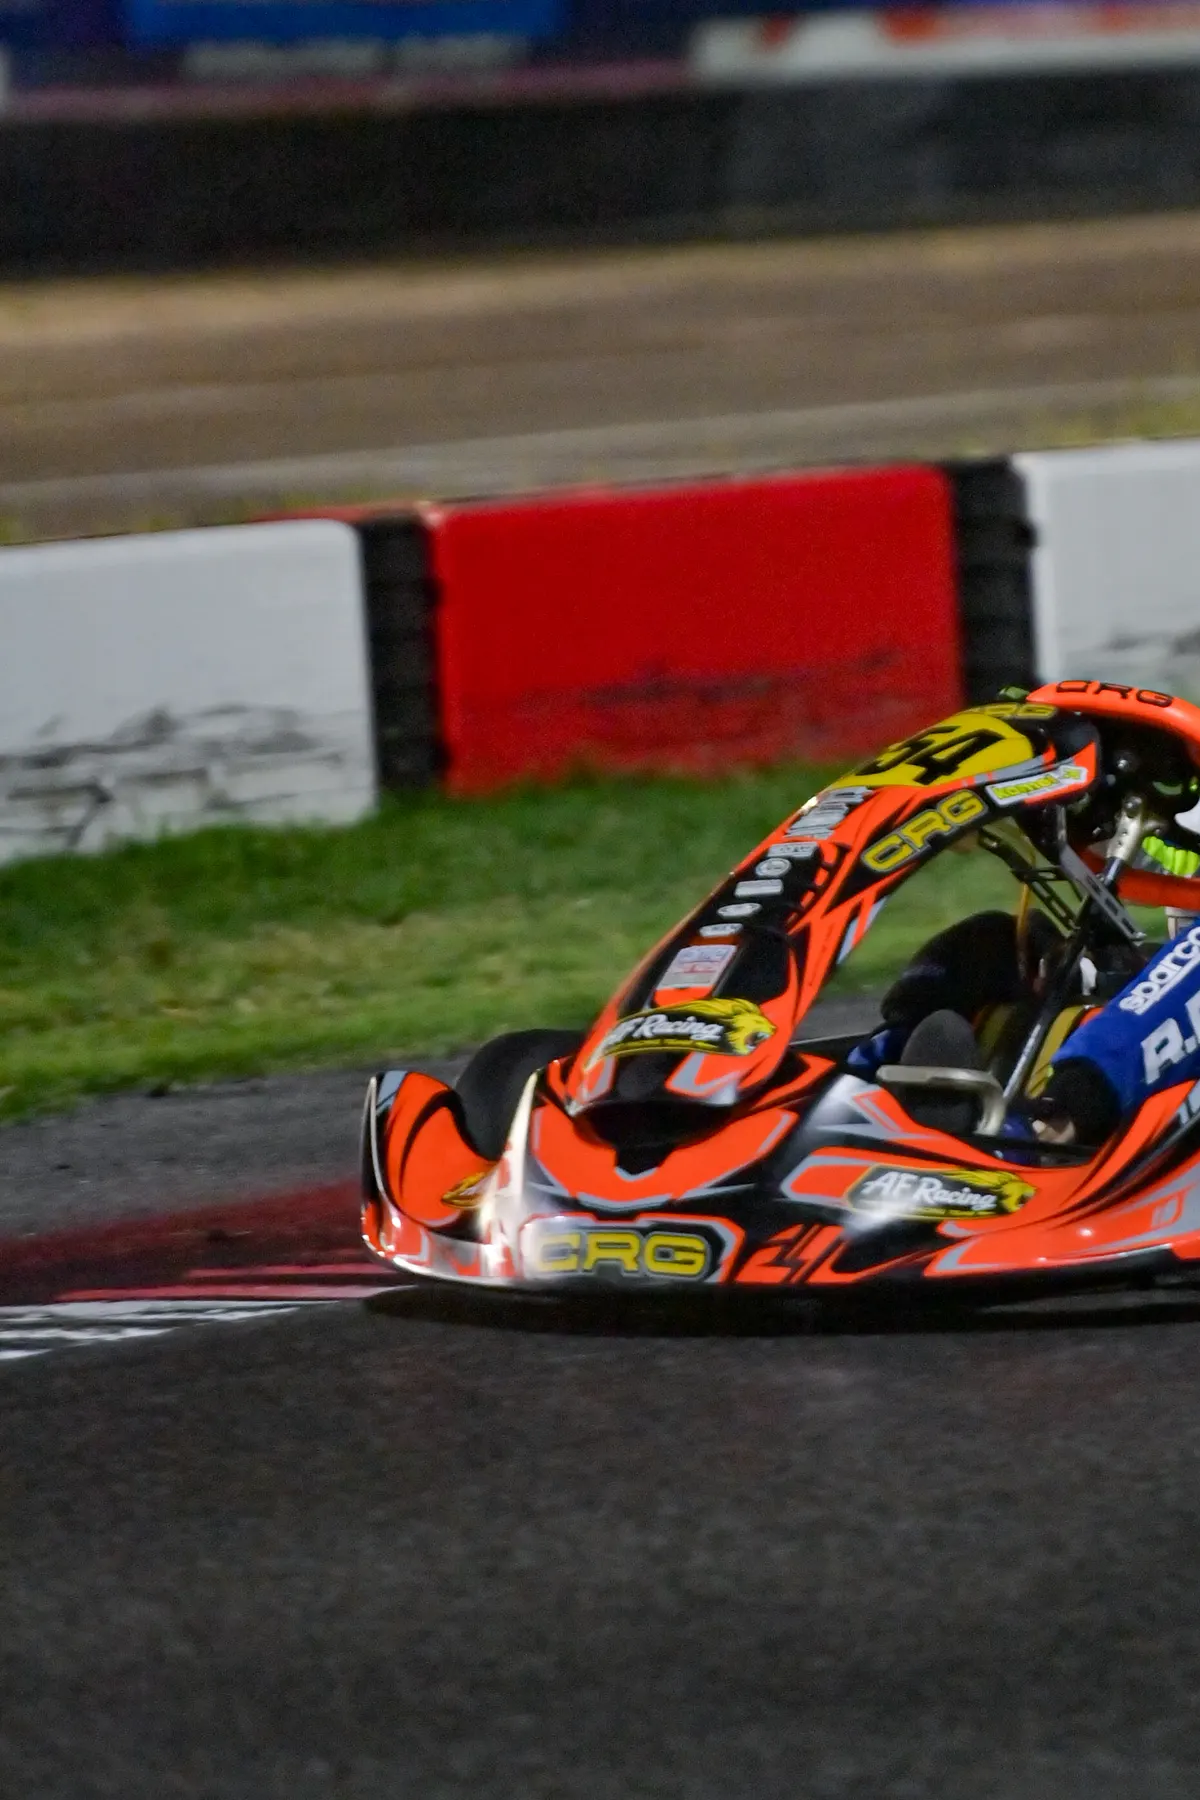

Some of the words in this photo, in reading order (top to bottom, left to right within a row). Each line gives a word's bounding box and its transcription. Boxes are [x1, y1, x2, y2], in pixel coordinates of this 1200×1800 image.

[1055, 679, 1174, 708] CRG
[861, 789, 988, 874] CRG
[632, 1013, 725, 1041] Racing
[860, 1170, 919, 1198] AF
[912, 1176, 998, 1211] Racing
[533, 1230, 707, 1277] CRG
